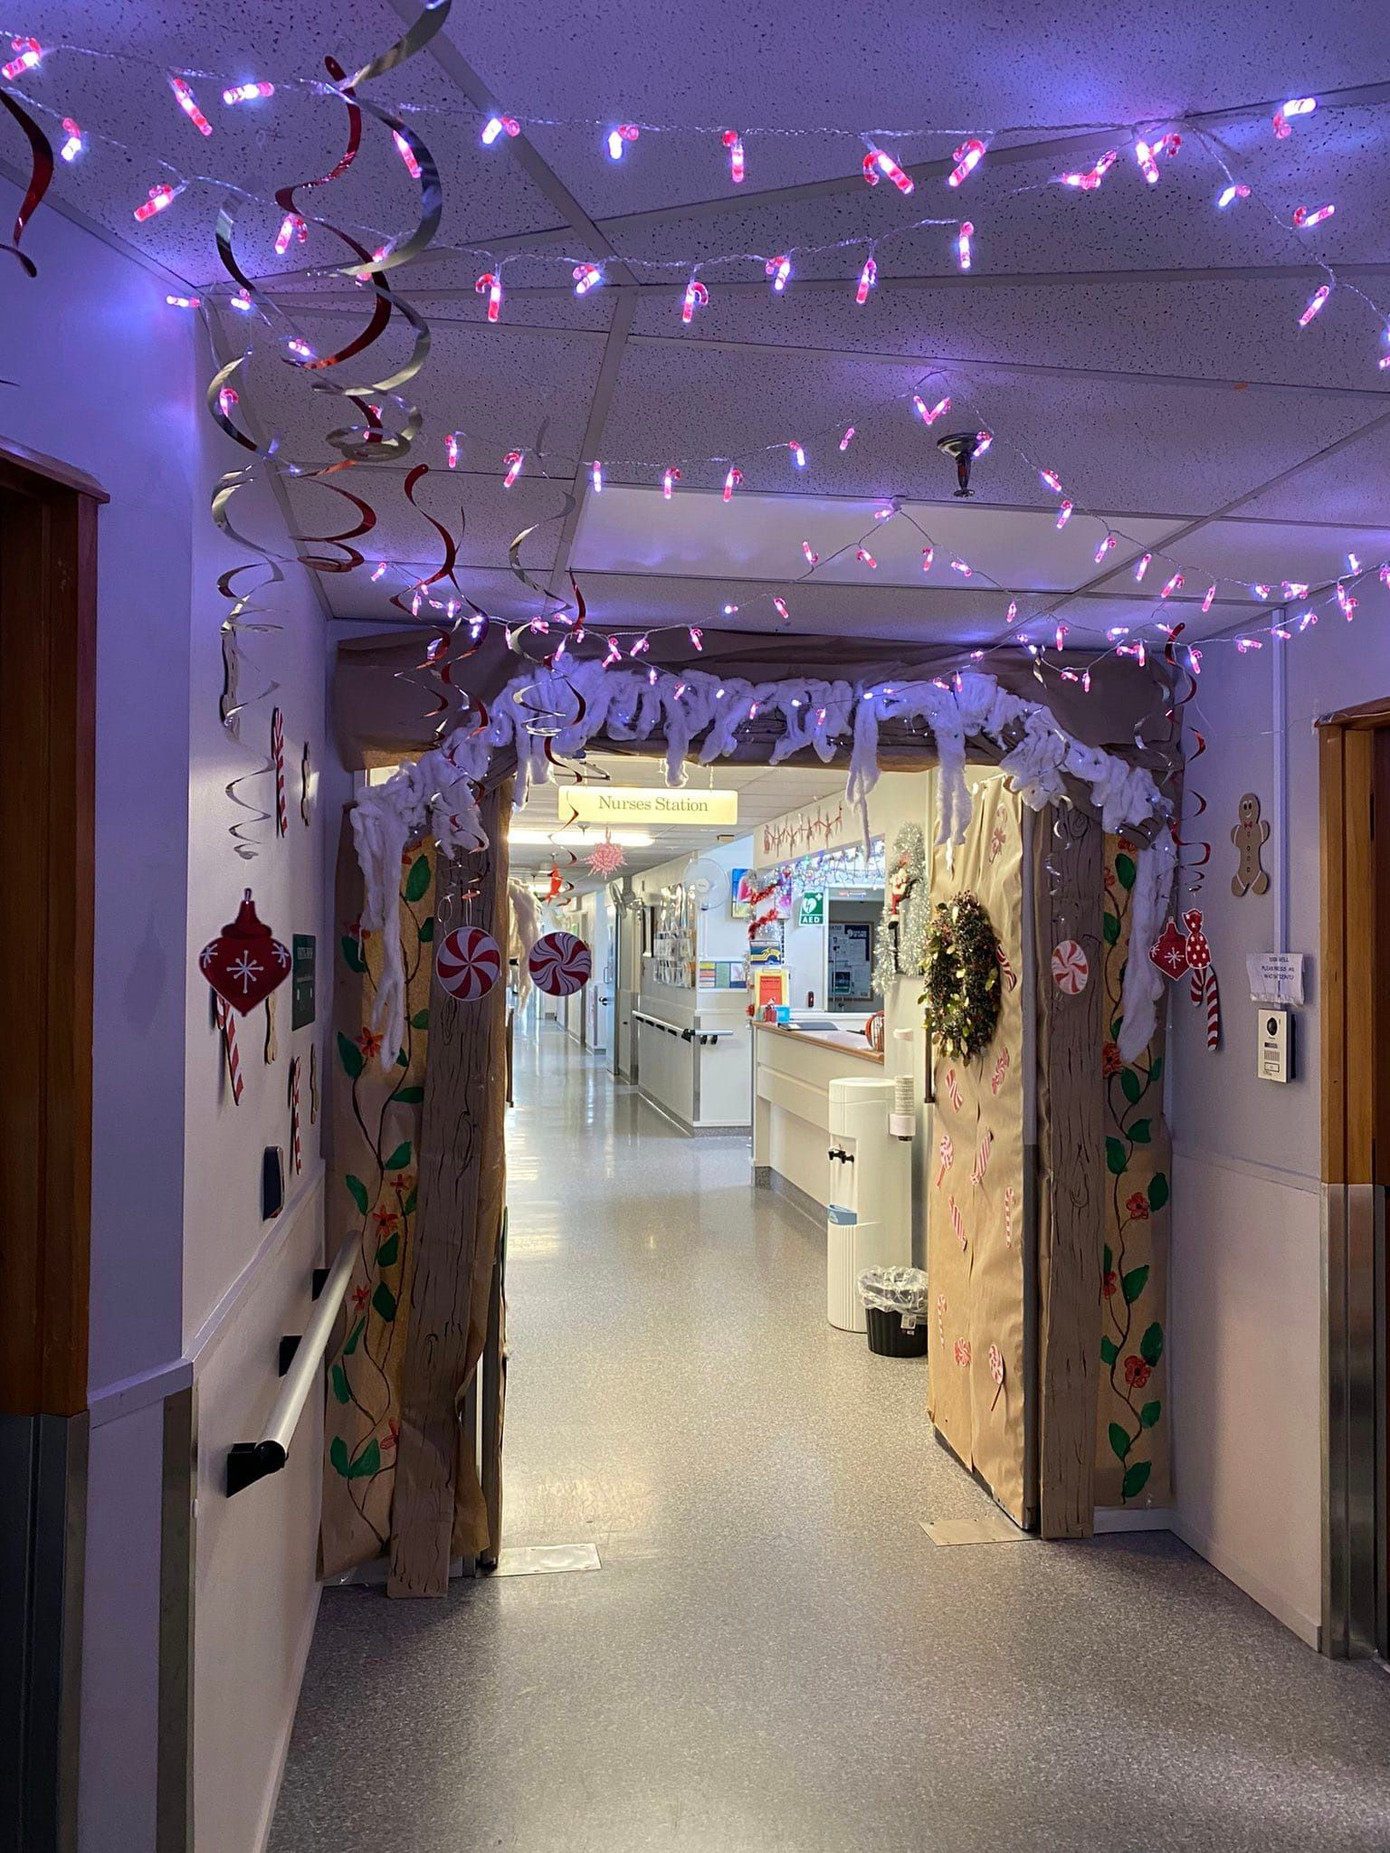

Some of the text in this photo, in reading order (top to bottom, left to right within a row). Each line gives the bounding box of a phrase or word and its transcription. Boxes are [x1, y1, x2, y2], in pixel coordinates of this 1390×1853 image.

[598, 795, 708, 812] Nurses Station
[802, 916, 820, 924] AED
